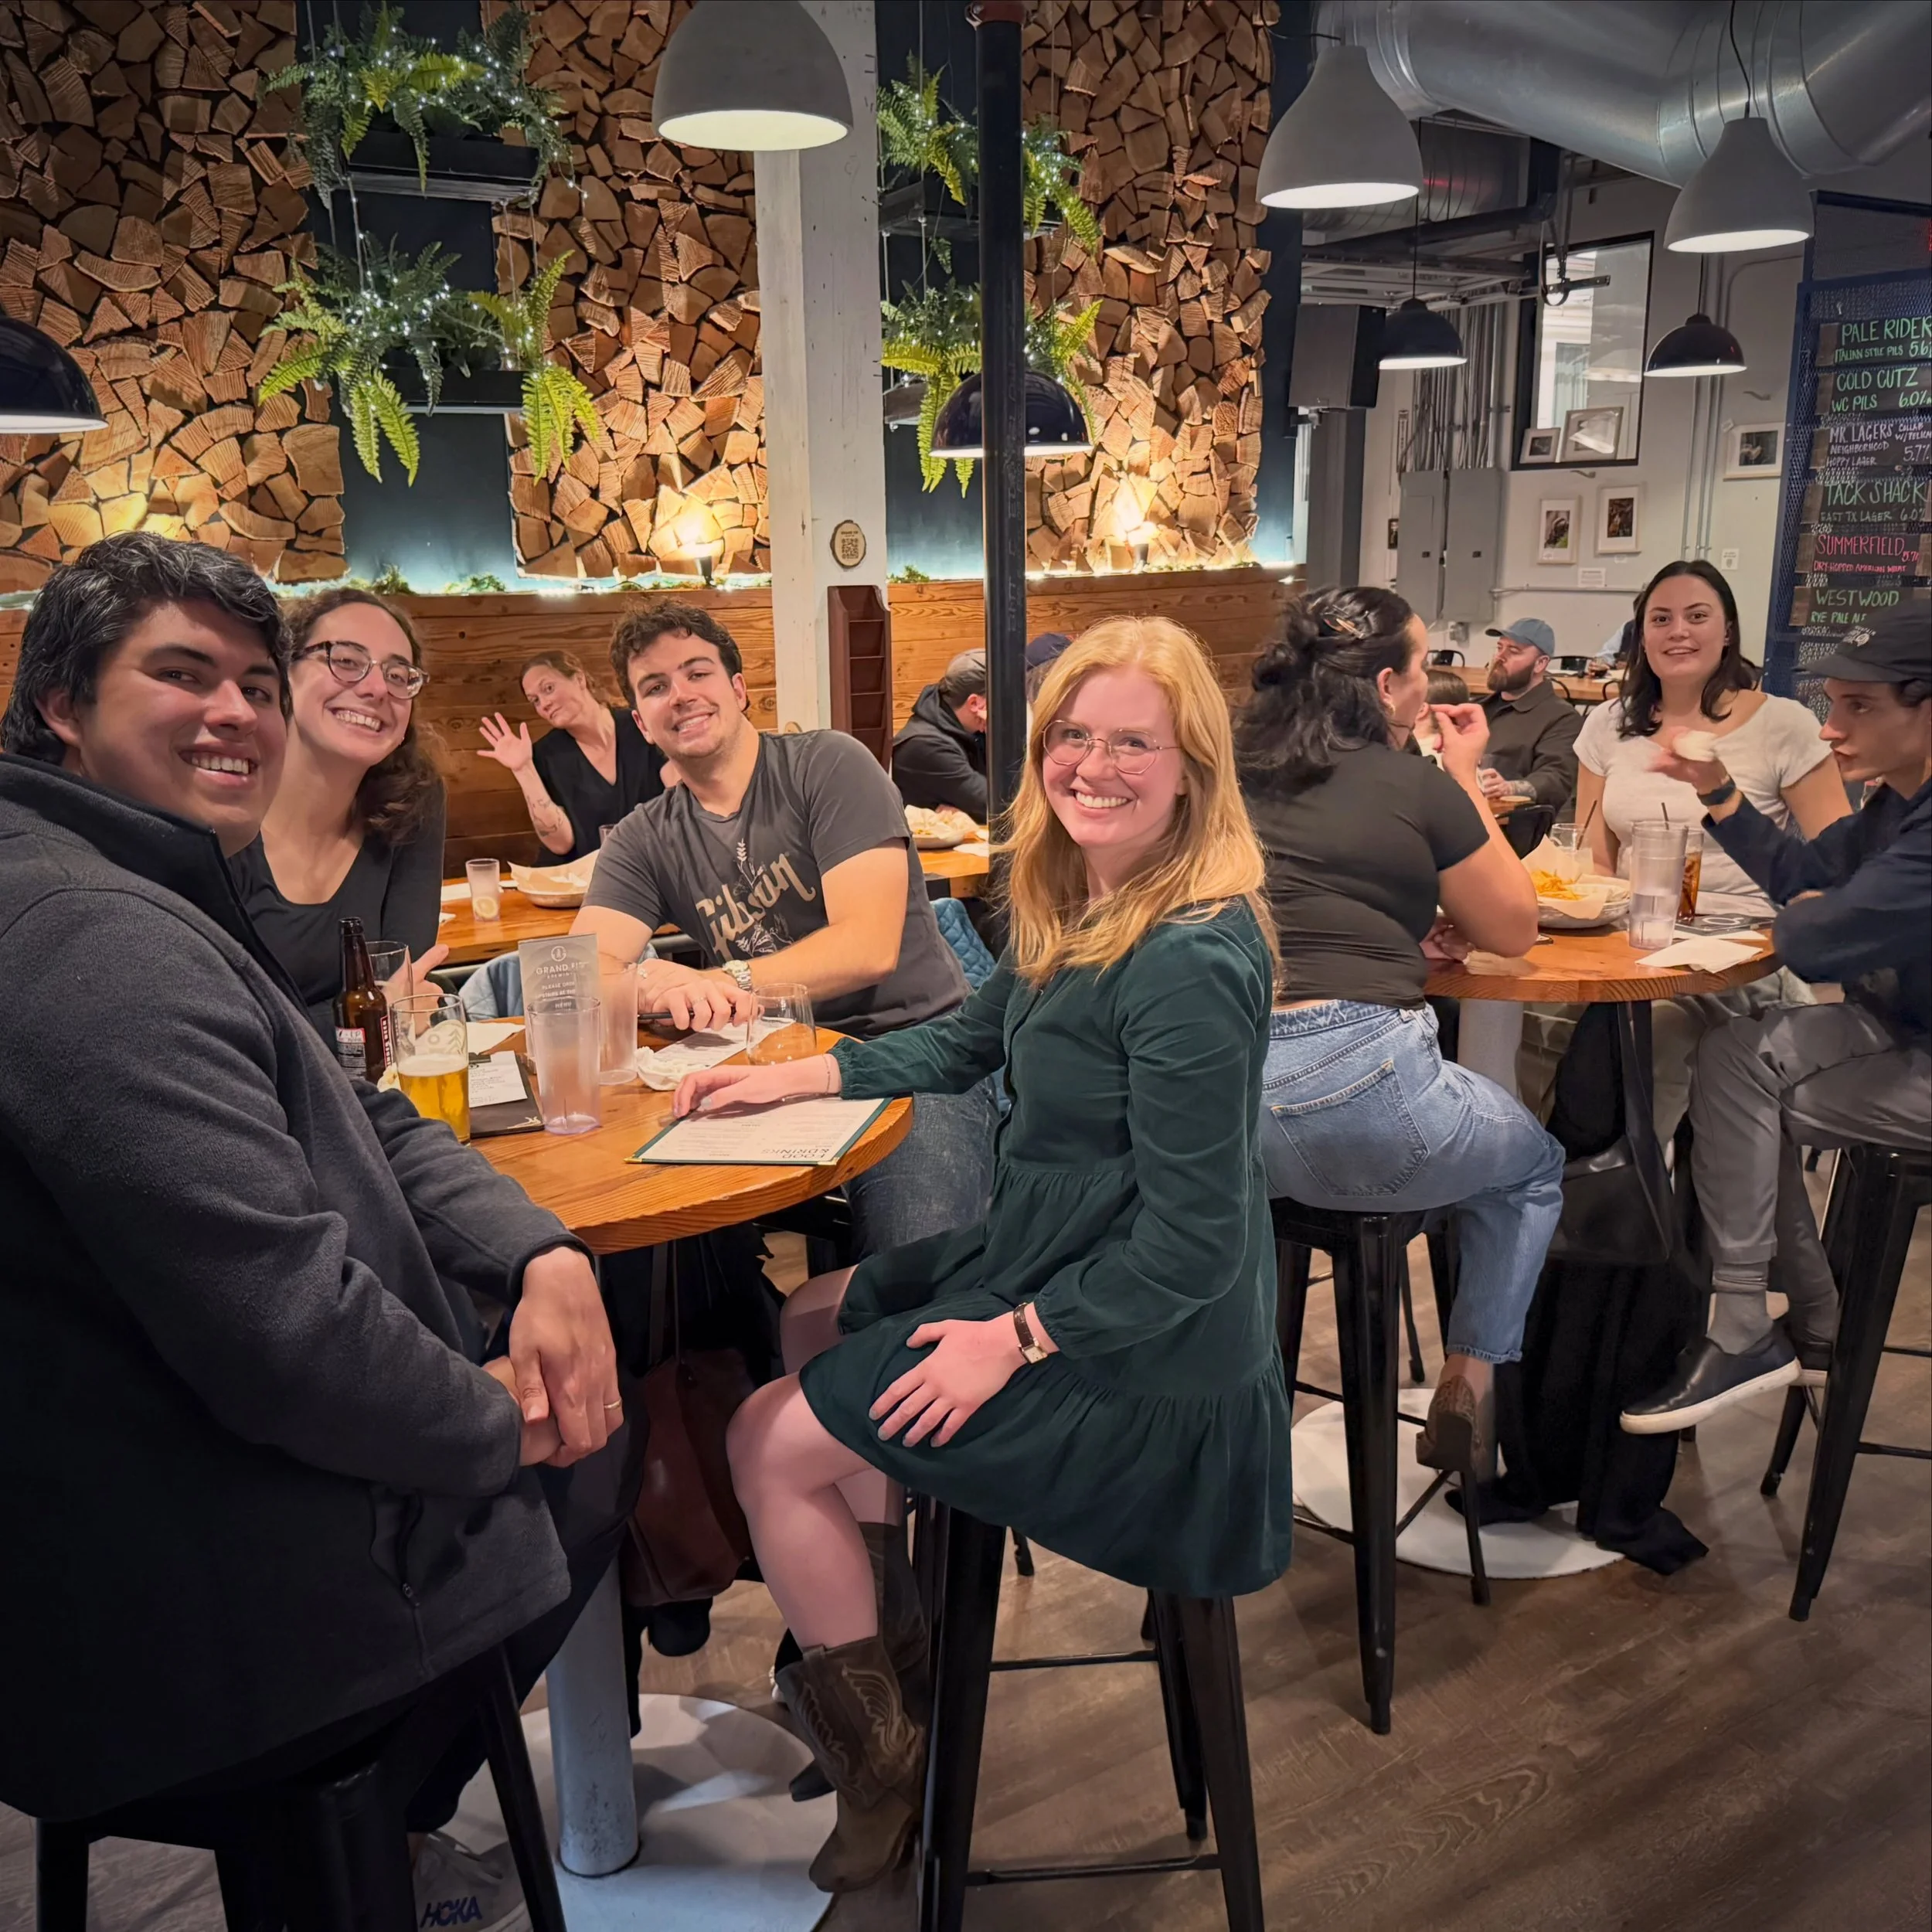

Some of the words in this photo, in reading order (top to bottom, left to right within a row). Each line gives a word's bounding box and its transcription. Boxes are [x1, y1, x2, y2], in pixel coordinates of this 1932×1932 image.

[1842, 321, 1879, 345] PALE
[1883, 315, 1931, 339] RIDER
[1835, 349, 1862, 363] ITALIAN
[1865, 346, 1885, 358] STYLE
[1887, 345, 1903, 356] PILS
[1837, 372, 1872, 392] COLD
[1877, 367, 1918, 389] CUTZ
[1832, 396, 1849, 412] WC
[1852, 393, 1877, 411] PILS
[1852, 423, 1893, 442] LAGERS
[1830, 440, 1889, 454] NEIGHBORHOOD
[1903, 444, 1930, 462] 5.7%
[1826, 456, 1850, 469] HOPPY
[1852, 456, 1876, 466] LAGER
[1825, 479, 1866, 506] TACK
[1869, 479, 1927, 504] SHACK
[1821, 511, 1842, 522] EAST
[1860, 511, 1892, 522] LAGER
[1815, 534, 1905, 556] SUMMERFIELD
[1816, 589, 1900, 607] WESTWOOD
[1811, 611, 1827, 623] RYE
[696, 852, 816, 961] Gibson
[536, 964, 569, 975] GRAND
[420, 1896, 482, 1927] HOKA
